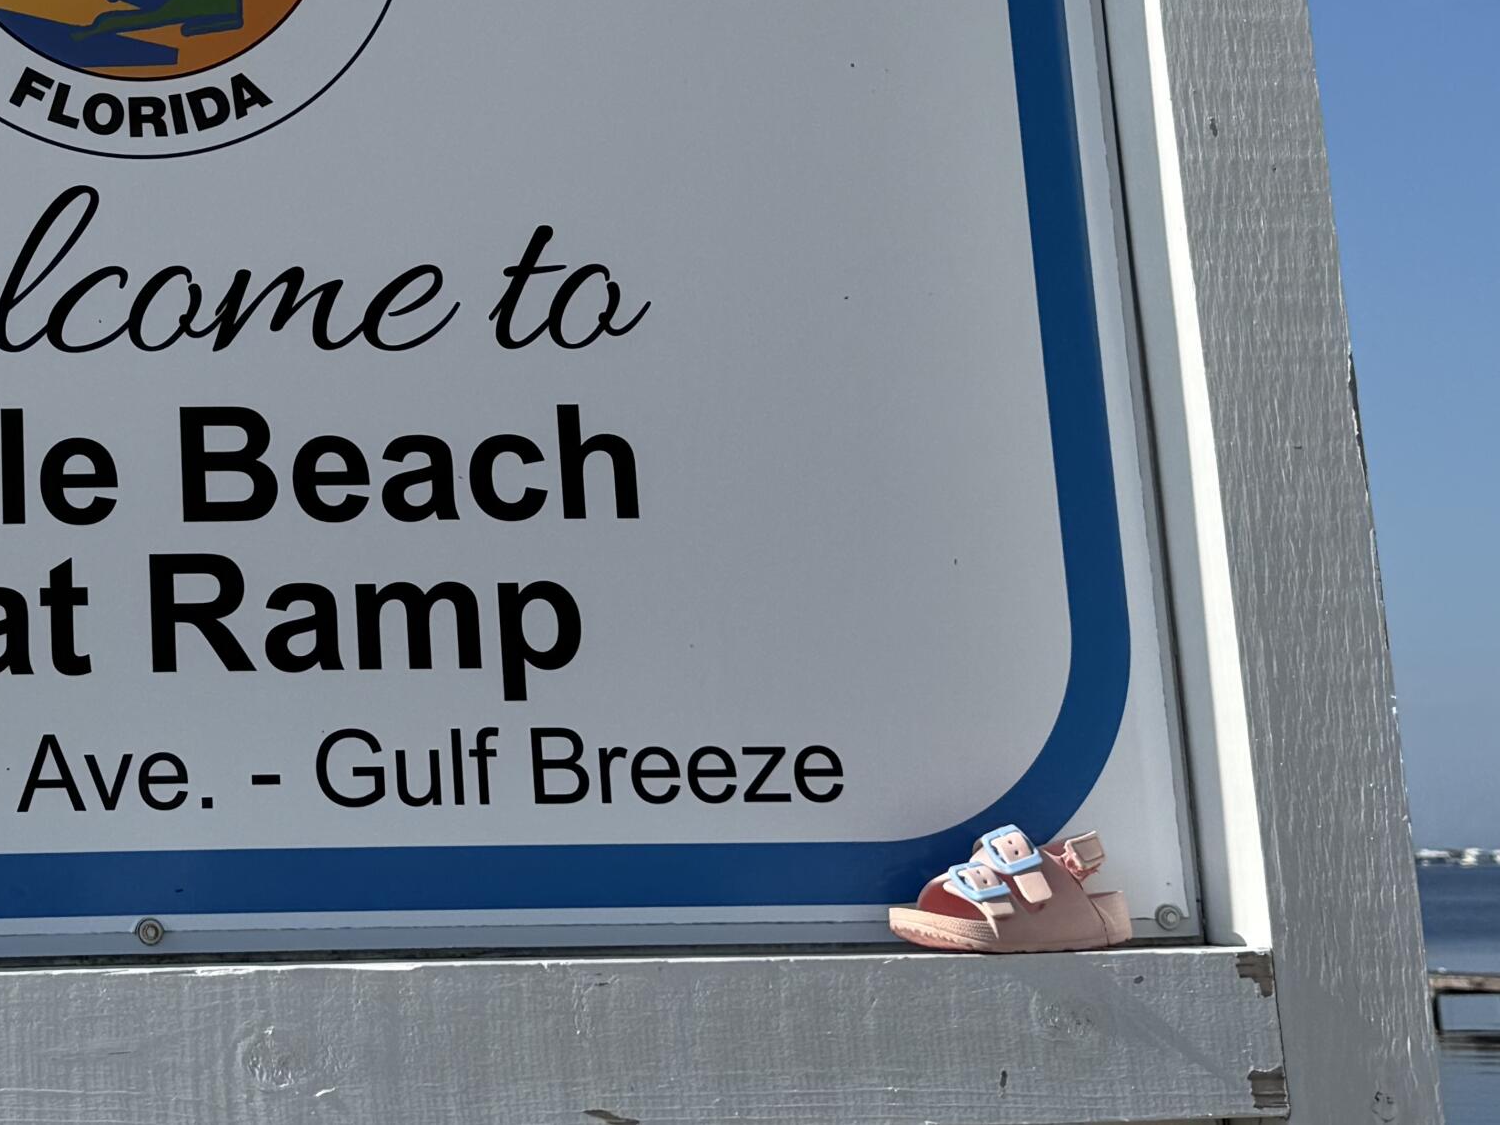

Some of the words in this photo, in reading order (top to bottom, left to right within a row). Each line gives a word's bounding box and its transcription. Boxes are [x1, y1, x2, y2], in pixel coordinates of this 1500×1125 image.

[9, 66, 274, 138] FLORIDA
[488, 224, 652, 350] to
[179, 403, 640, 523] Beach
[148, 553, 582, 702] Ramp
[16, 734, 214, 813] Ave.
[251, 774, 281, 786] -
[315, 726, 499, 808] Gulf
[530, 727, 844, 805] Breeze
